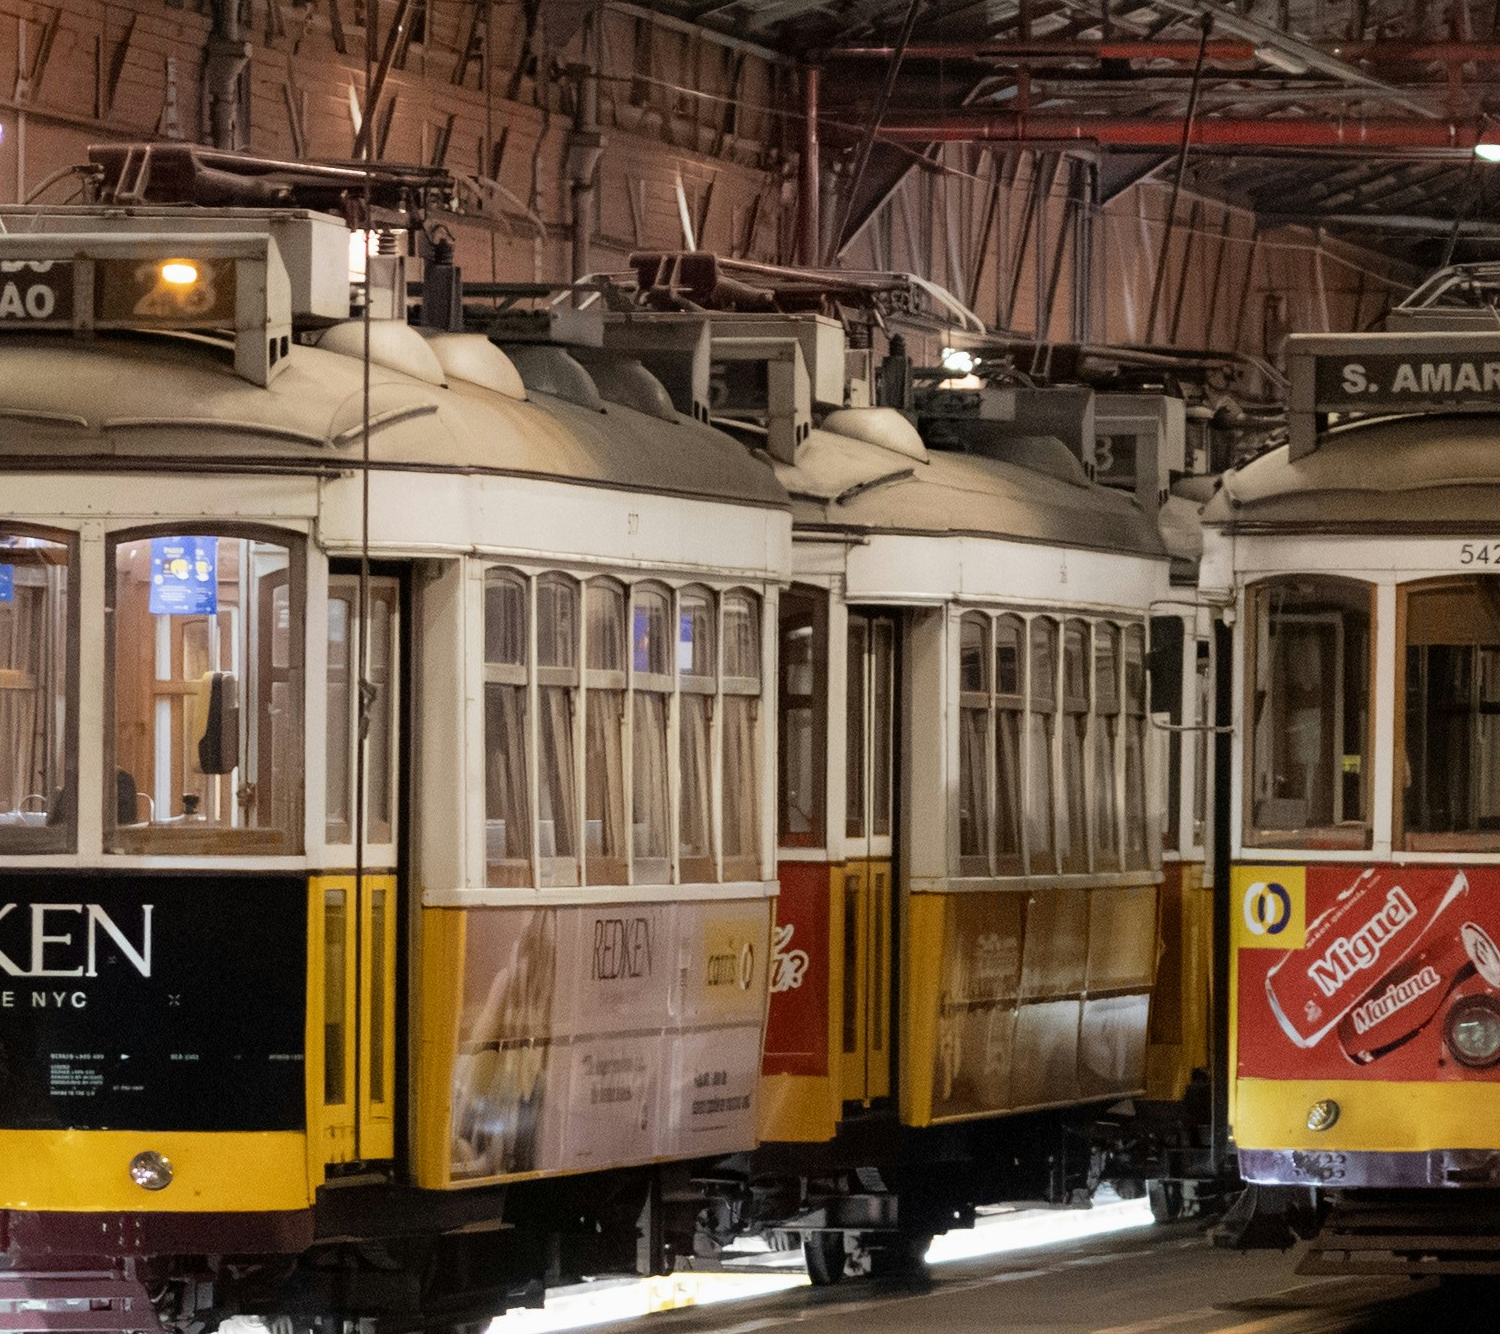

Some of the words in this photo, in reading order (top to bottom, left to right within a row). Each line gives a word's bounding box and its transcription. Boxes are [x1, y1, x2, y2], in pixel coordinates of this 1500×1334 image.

[1341, 363, 1379, 394] S.
[1309, 887, 1417, 996] Miguel
[32, 991, 88, 1009] NYC
[1352, 968, 1440, 1033] Mariana
